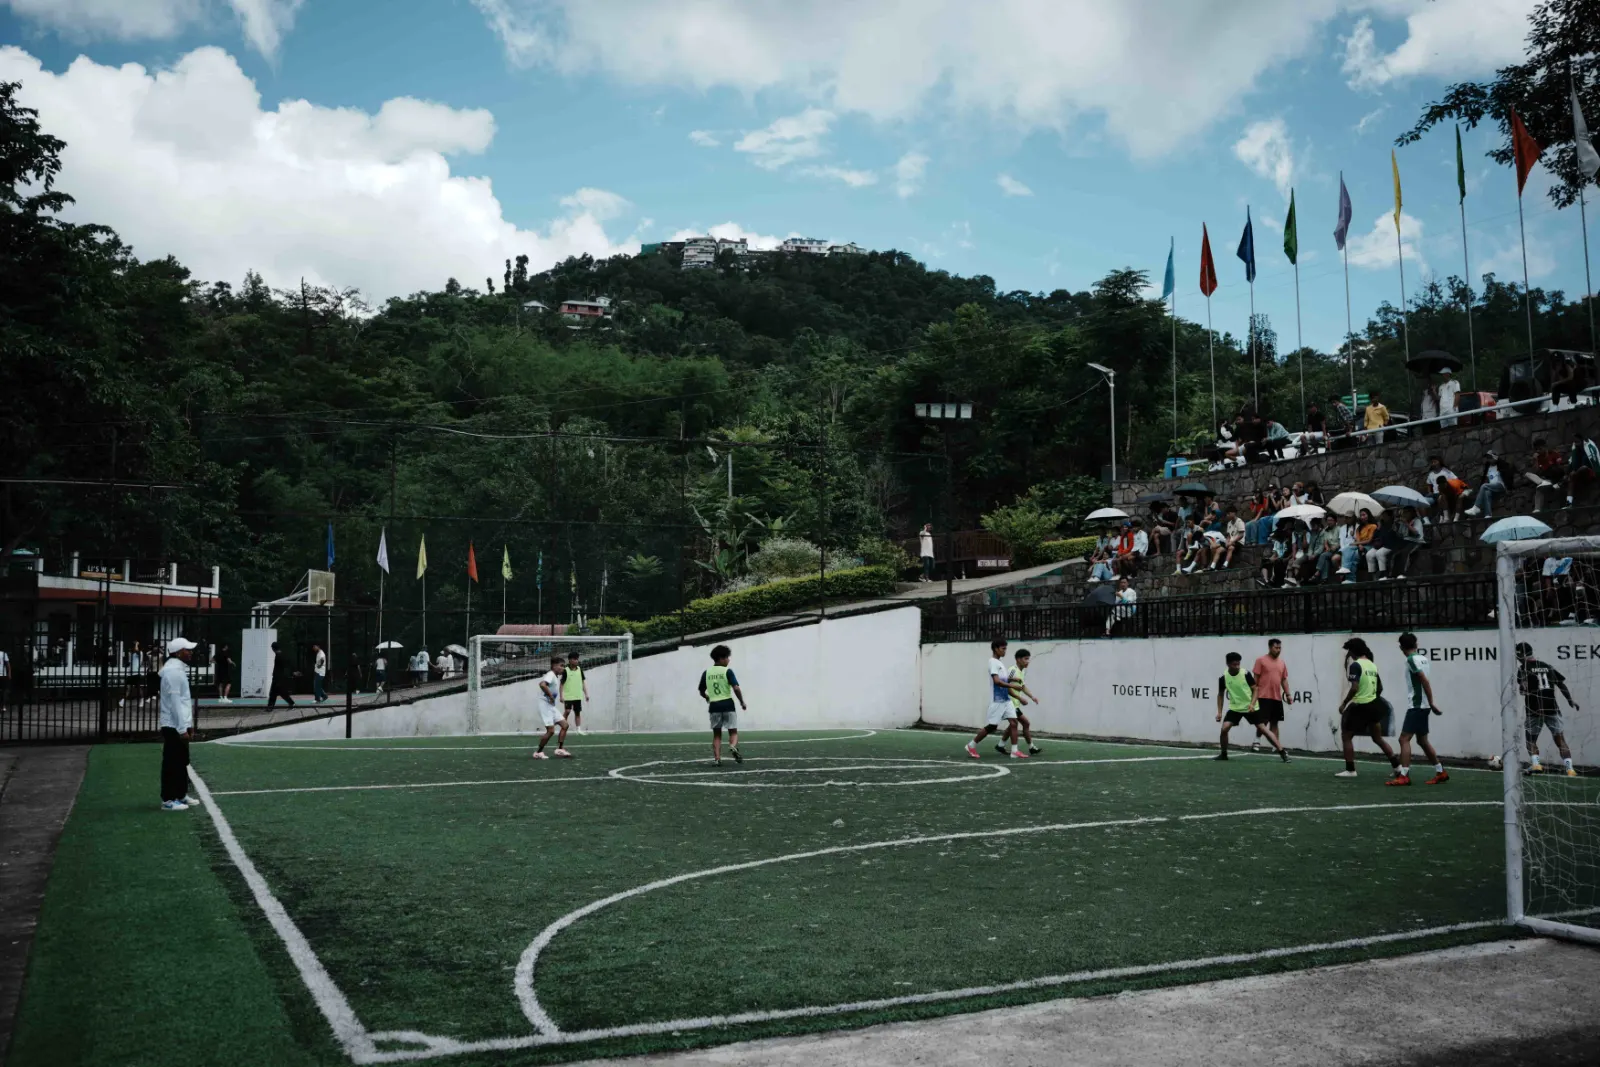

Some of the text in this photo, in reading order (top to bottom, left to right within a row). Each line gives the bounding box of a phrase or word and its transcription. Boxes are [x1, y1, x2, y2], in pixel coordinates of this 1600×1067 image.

[100, 565, 116, 574] WK
[1537, 672, 1550, 689] 11
[713, 682, 721, 695] 8
[1112, 684, 1177, 698] TOGETHER
[1191, 687, 1210, 700] WE
